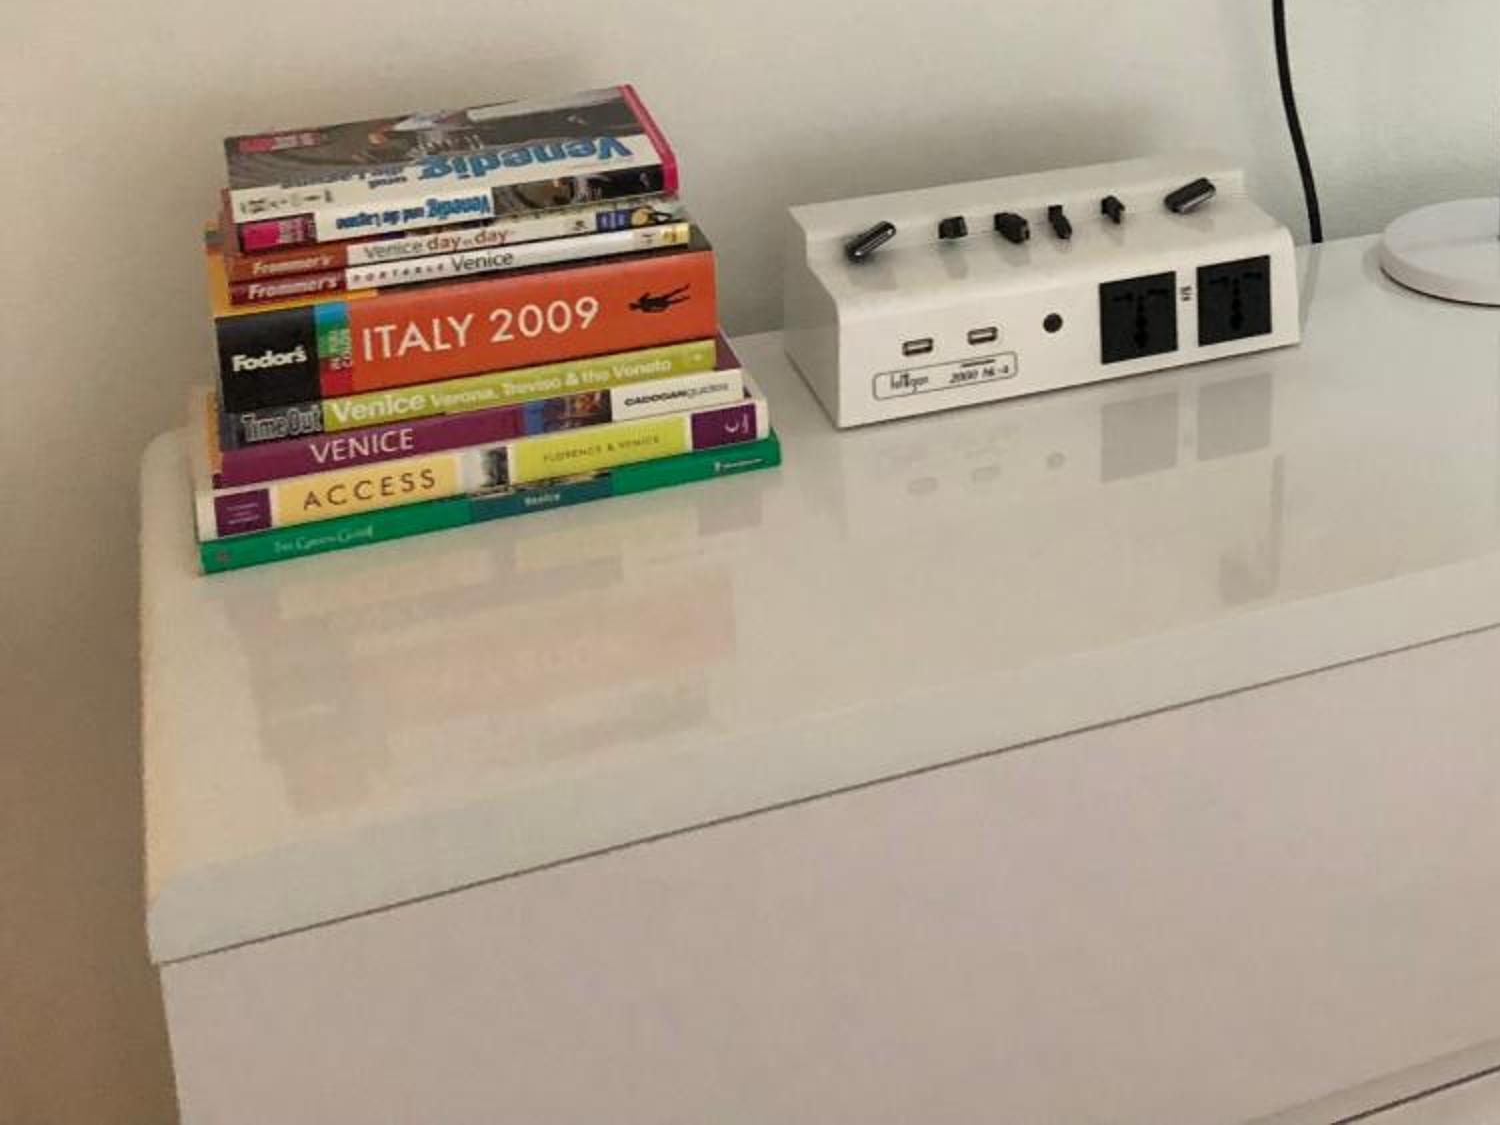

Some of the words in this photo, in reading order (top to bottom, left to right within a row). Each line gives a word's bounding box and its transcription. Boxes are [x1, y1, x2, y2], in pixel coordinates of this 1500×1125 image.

[418, 136, 632, 179] Venedig
[426, 194, 491, 219] Venedig
[364, 239, 423, 259] Venice
[427, 235, 461, 252] day
[474, 228, 510, 245] day
[452, 252, 514, 271] Venice
[248, 276, 338, 300] Frommer's
[363, 313, 475, 362] ITALY
[488, 296, 600, 346] 2009
[231, 345, 308, 372] Fodor's
[332, 392, 425, 423] Venice
[502, 377, 562, 398] Treviso
[565, 371, 579, 387] &
[582, 366, 610, 385] the
[310, 428, 415, 464] VENICE
[543, 446, 602, 464] FLORENCE
[618, 435, 661, 451] VENICE
[302, 468, 437, 511] ACCESS
